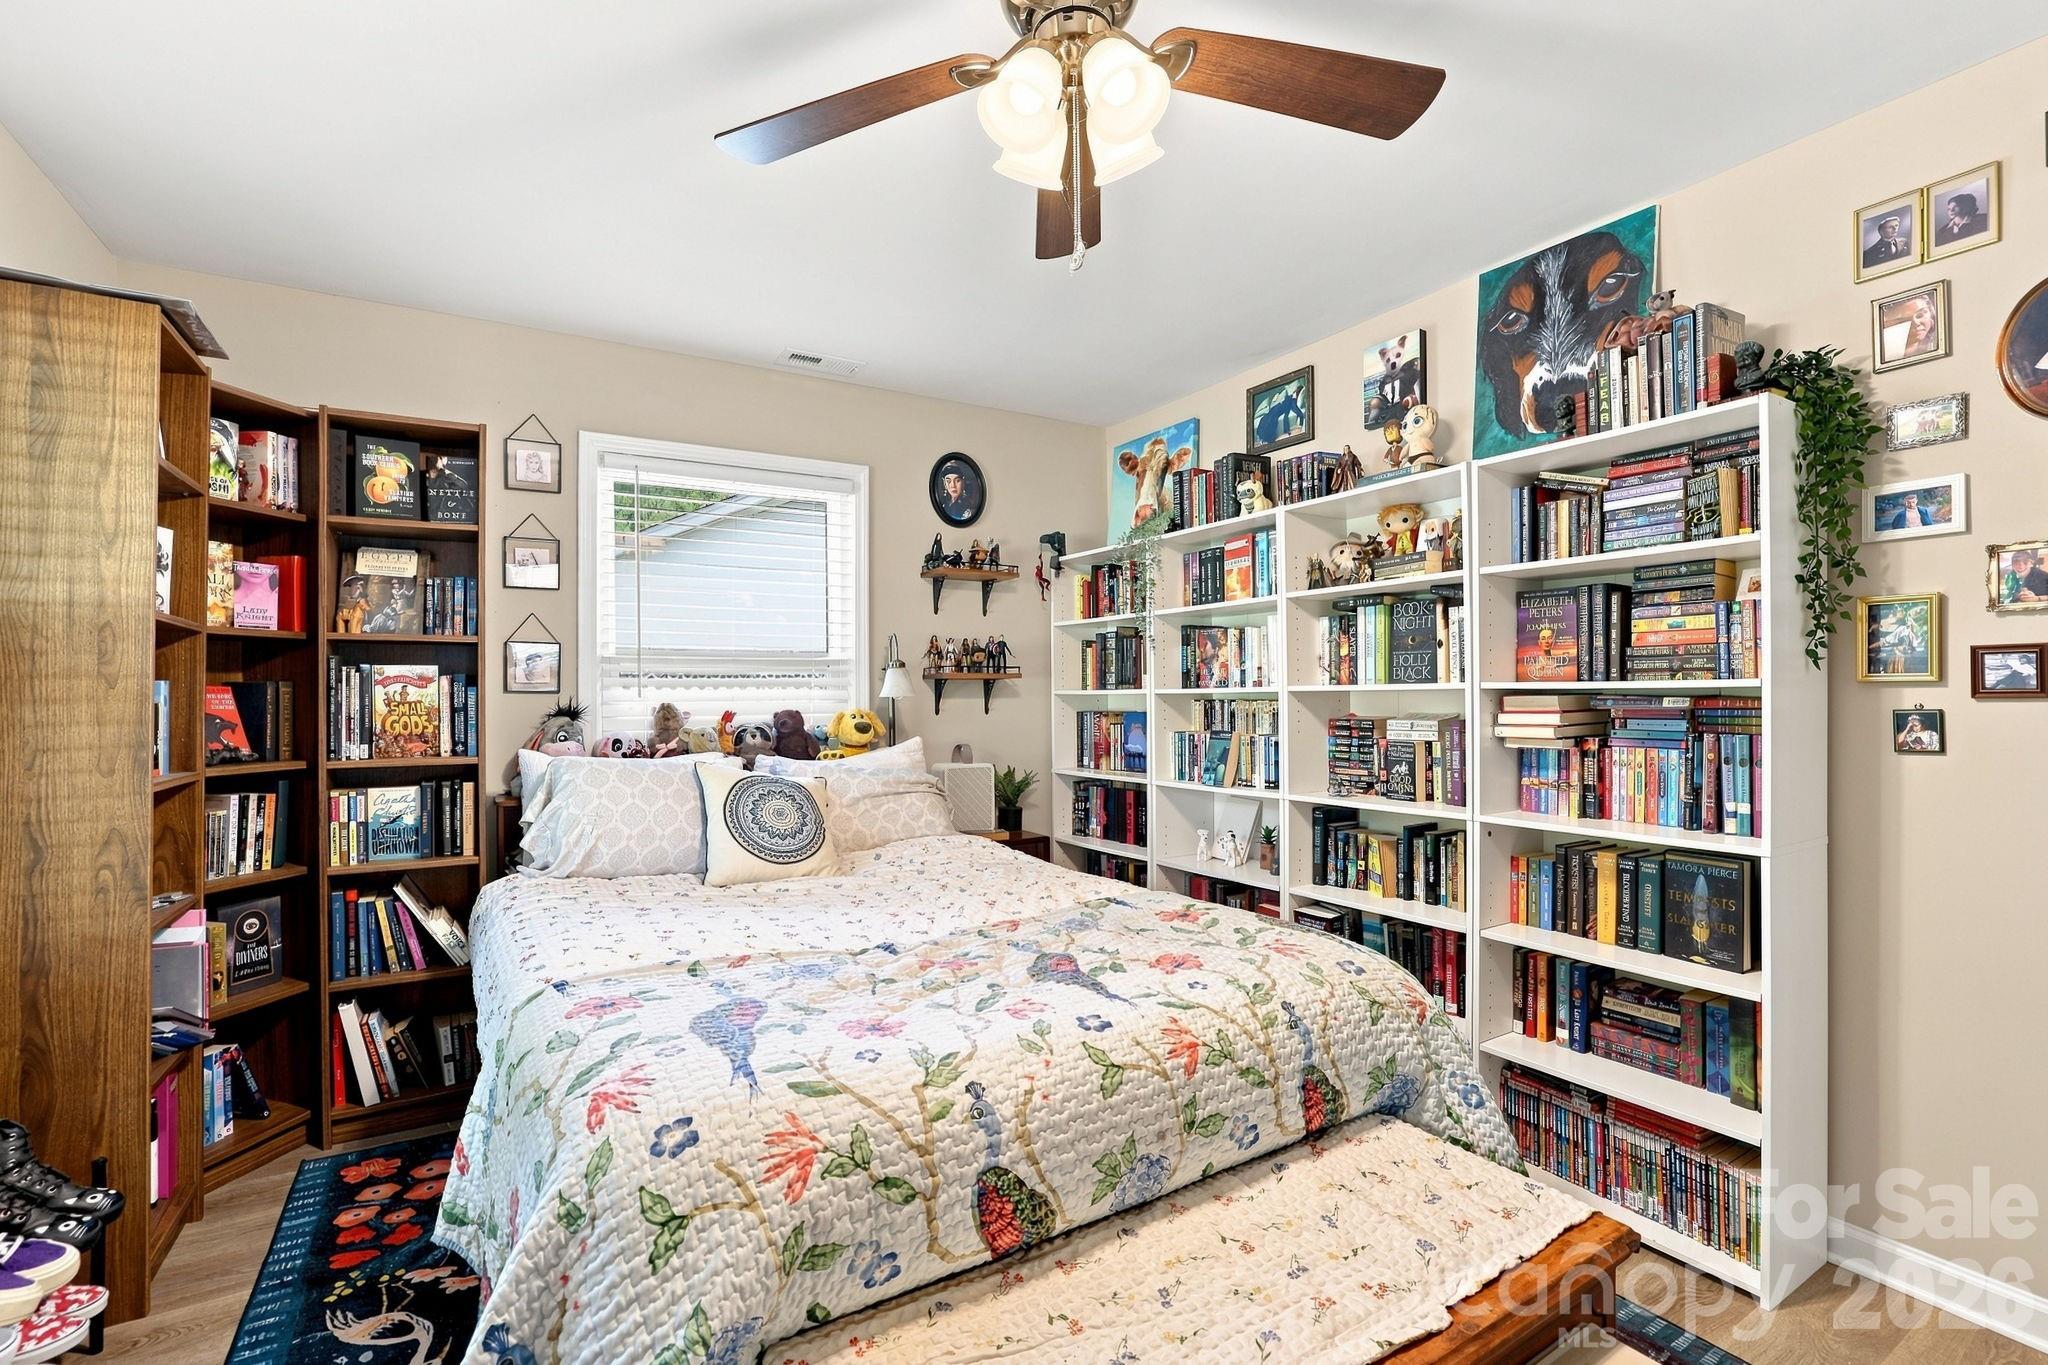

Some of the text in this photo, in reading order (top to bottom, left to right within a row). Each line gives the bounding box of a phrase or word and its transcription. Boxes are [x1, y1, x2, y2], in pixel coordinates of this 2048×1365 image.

[428, 489, 475, 498] NETTLE
[1393, 600, 1430, 617] BOOK
[1520, 596, 1573, 608] ELIZABETH
[1529, 607, 1563, 618] PETERS
[1393, 616, 1434, 631] NIGHT
[1393, 654, 1431, 666] HOLLY
[1524, 655, 1569, 666] PAINTED
[1393, 666, 1431, 682] BLACK
[1527, 666, 1564, 680] QUEEN
[390, 701, 428, 715] SMALL
[385, 715, 433, 735] GODS
[1390, 774, 1412, 784] GOOD
[372, 826, 420, 840] DESTINATION
[372, 839, 420, 856] UNKNOWN
[1666, 862, 1738, 880] TAMORA PIERCE
[1668, 889, 1736, 911] TEMSTS
[236, 945, 268, 966] DIVINERS
